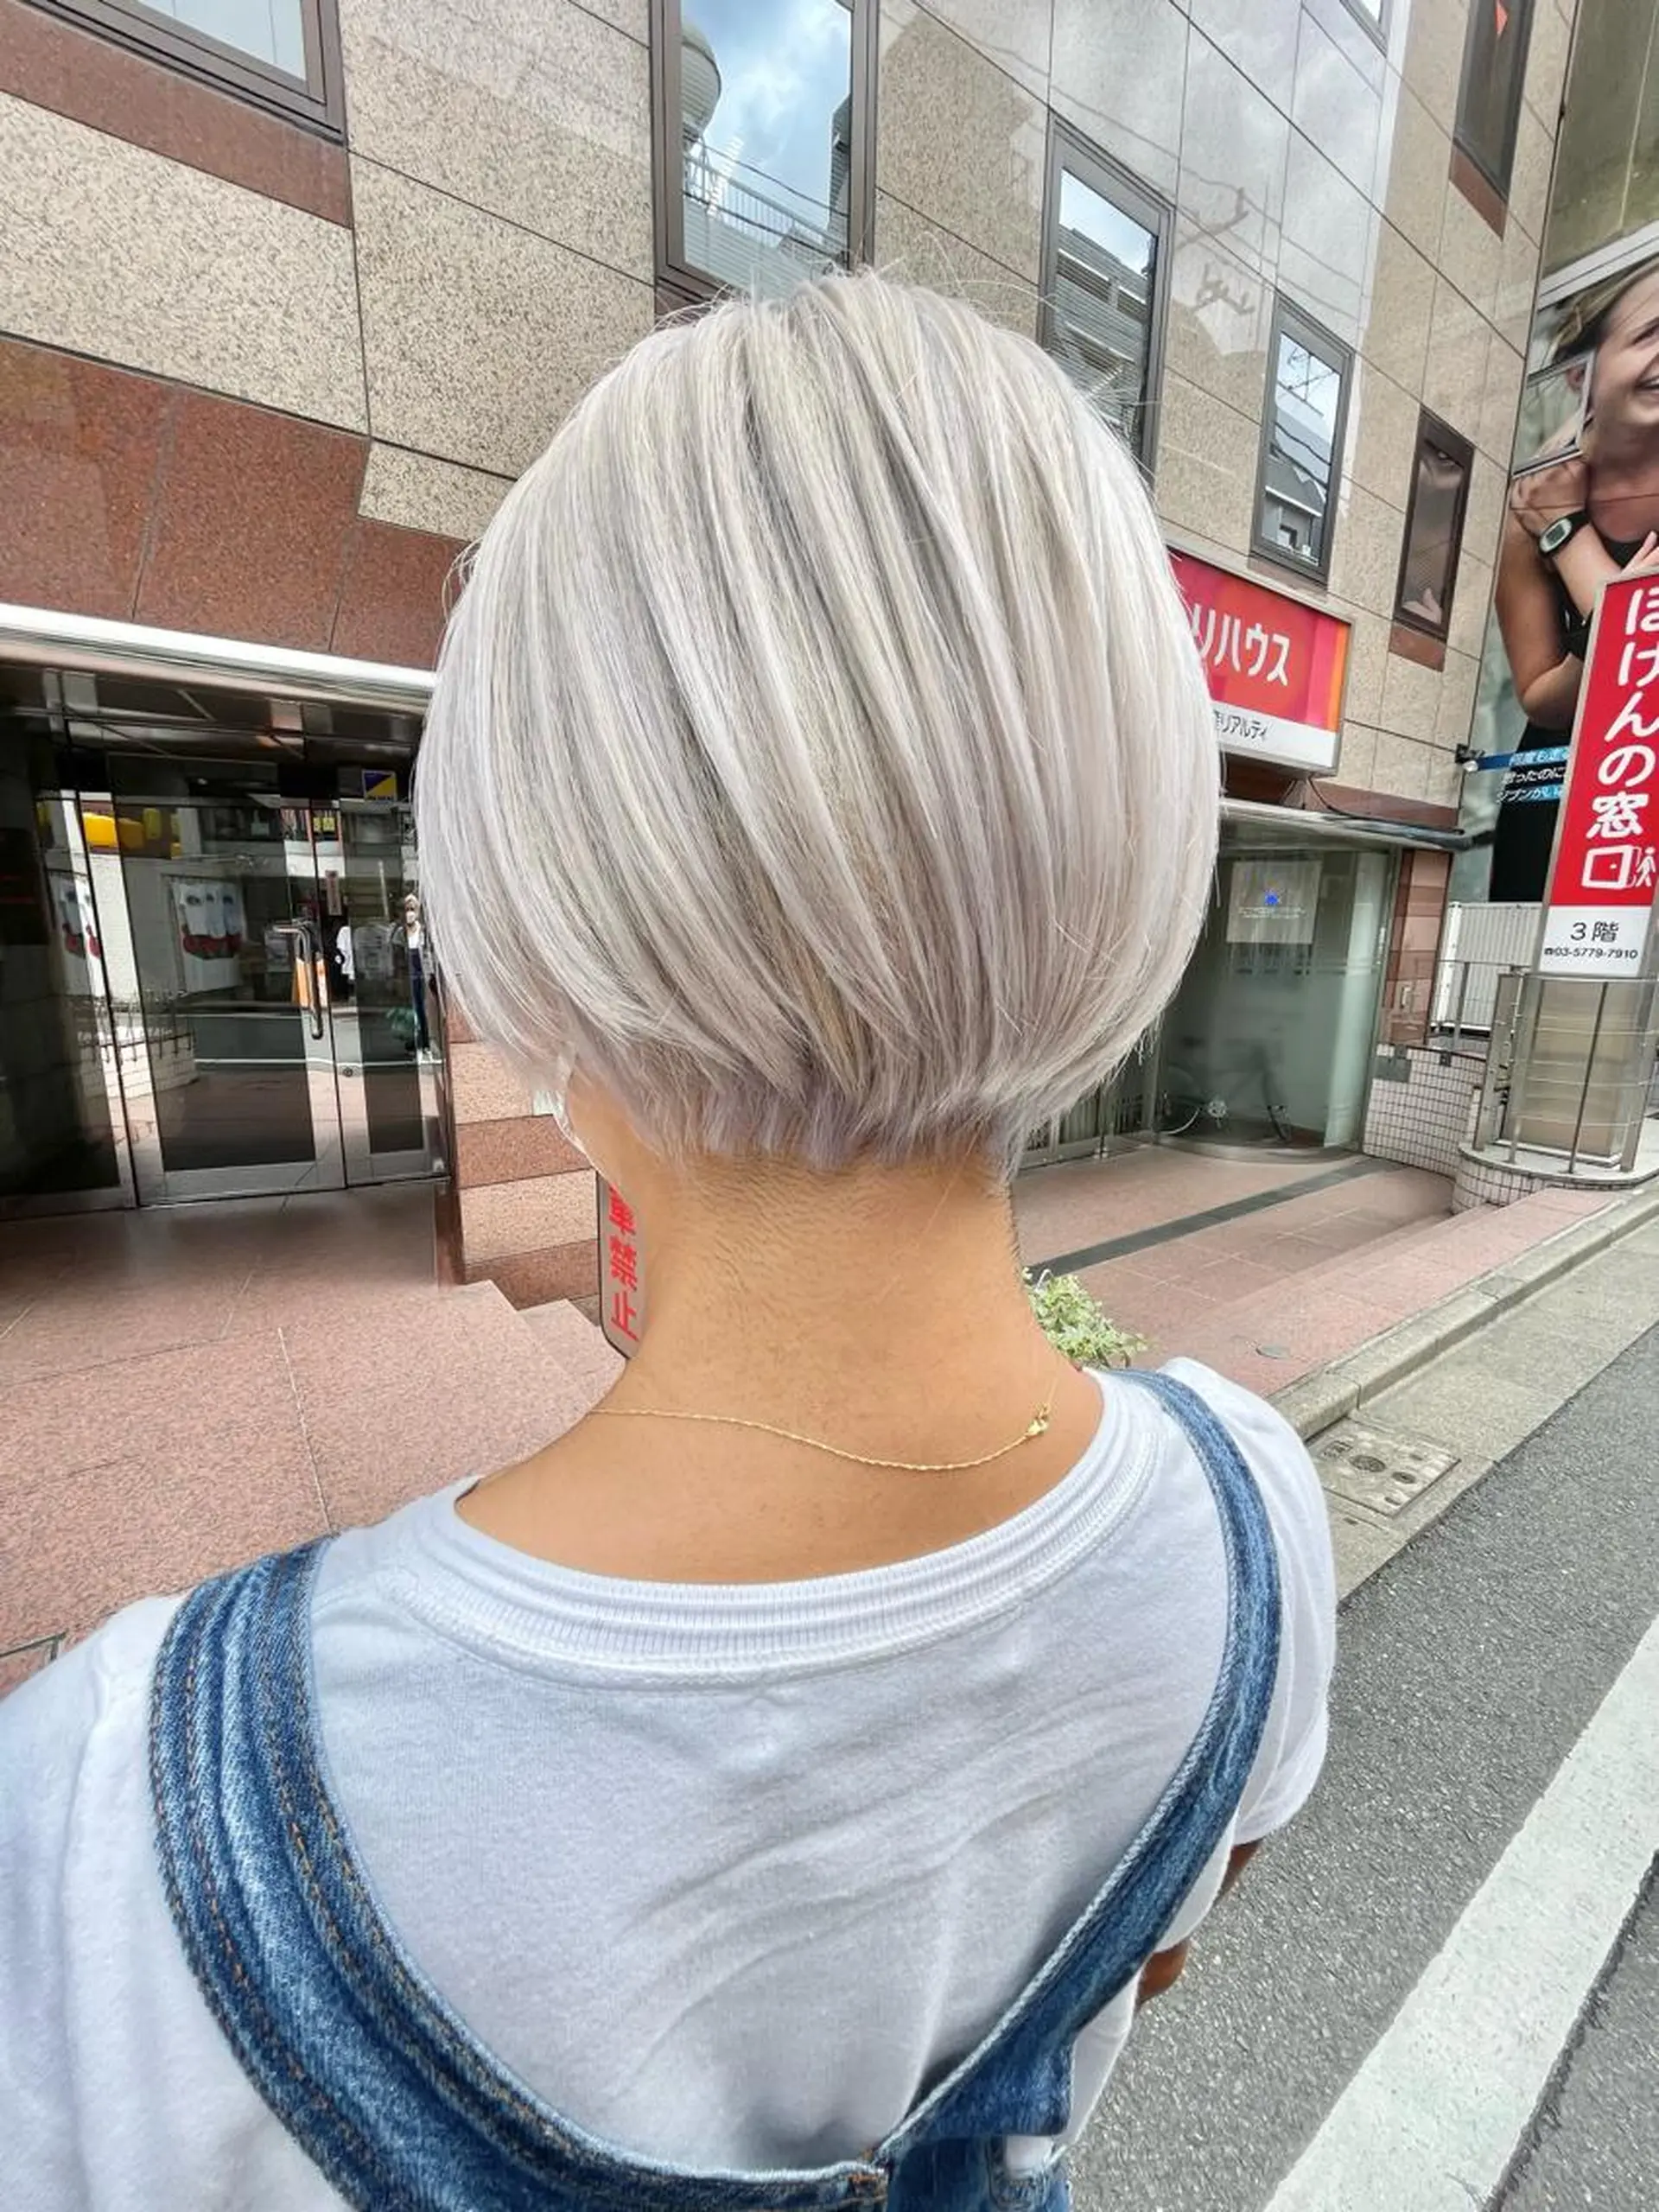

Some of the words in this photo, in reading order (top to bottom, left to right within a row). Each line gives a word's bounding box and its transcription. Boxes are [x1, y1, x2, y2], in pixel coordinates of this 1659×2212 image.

[1192, 602, 1291, 686] リハウス
[1581, 588, 1659, 890] ほけんの窓口
